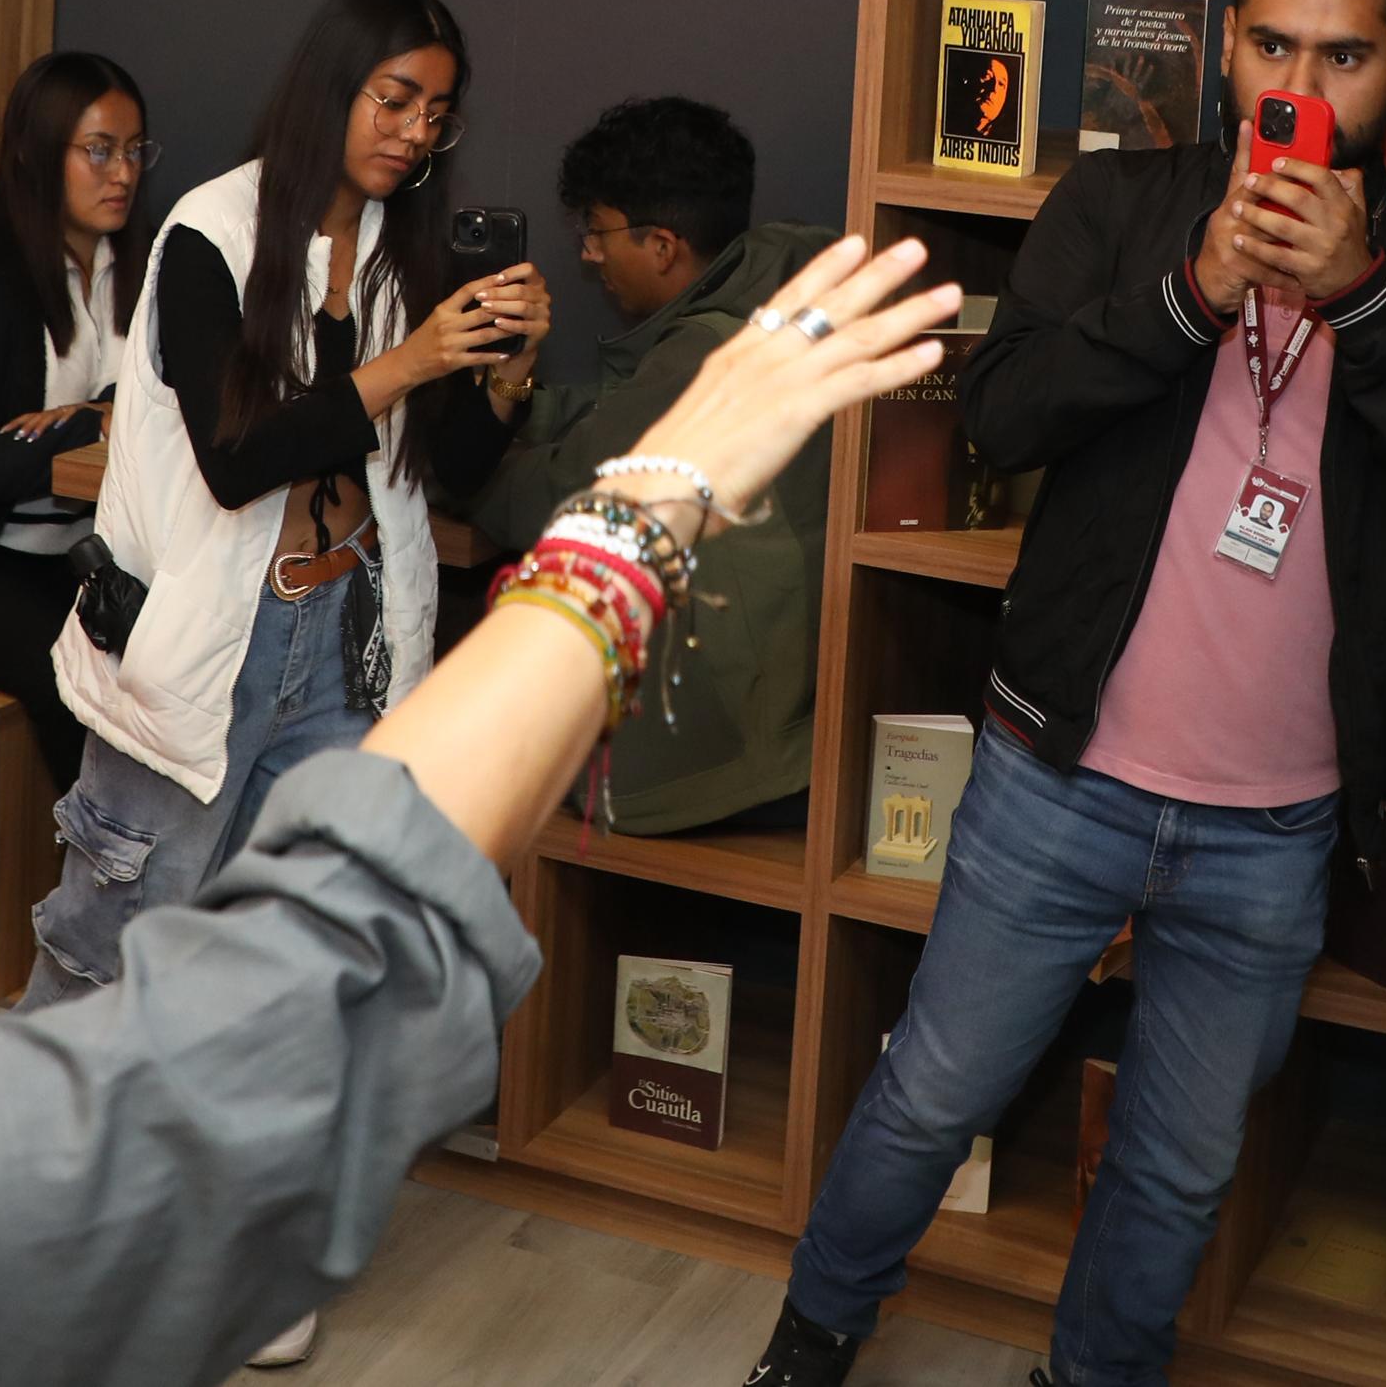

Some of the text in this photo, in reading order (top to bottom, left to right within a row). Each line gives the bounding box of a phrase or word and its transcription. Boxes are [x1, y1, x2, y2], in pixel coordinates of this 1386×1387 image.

[948, 7, 1014, 32] ATAHUALPA
[1105, 5, 1185, 21] Primer encuentro
[1095, 28, 1102, 37] y
[1104, 27, 1155, 39] narradores
[1121, 17, 1167, 32] de poetas
[961, 26, 1023, 53] YUPANQUI
[1097, 37, 1188, 53] de la frontera norte
[940, 138, 1020, 167] AIRES INDIOS
[878, 389, 917, 401] CIEN
[885, 744, 939, 762] Tragedias
[643, 1080, 679, 1103] Sitio
[628, 1087, 702, 1124] Cuautla
